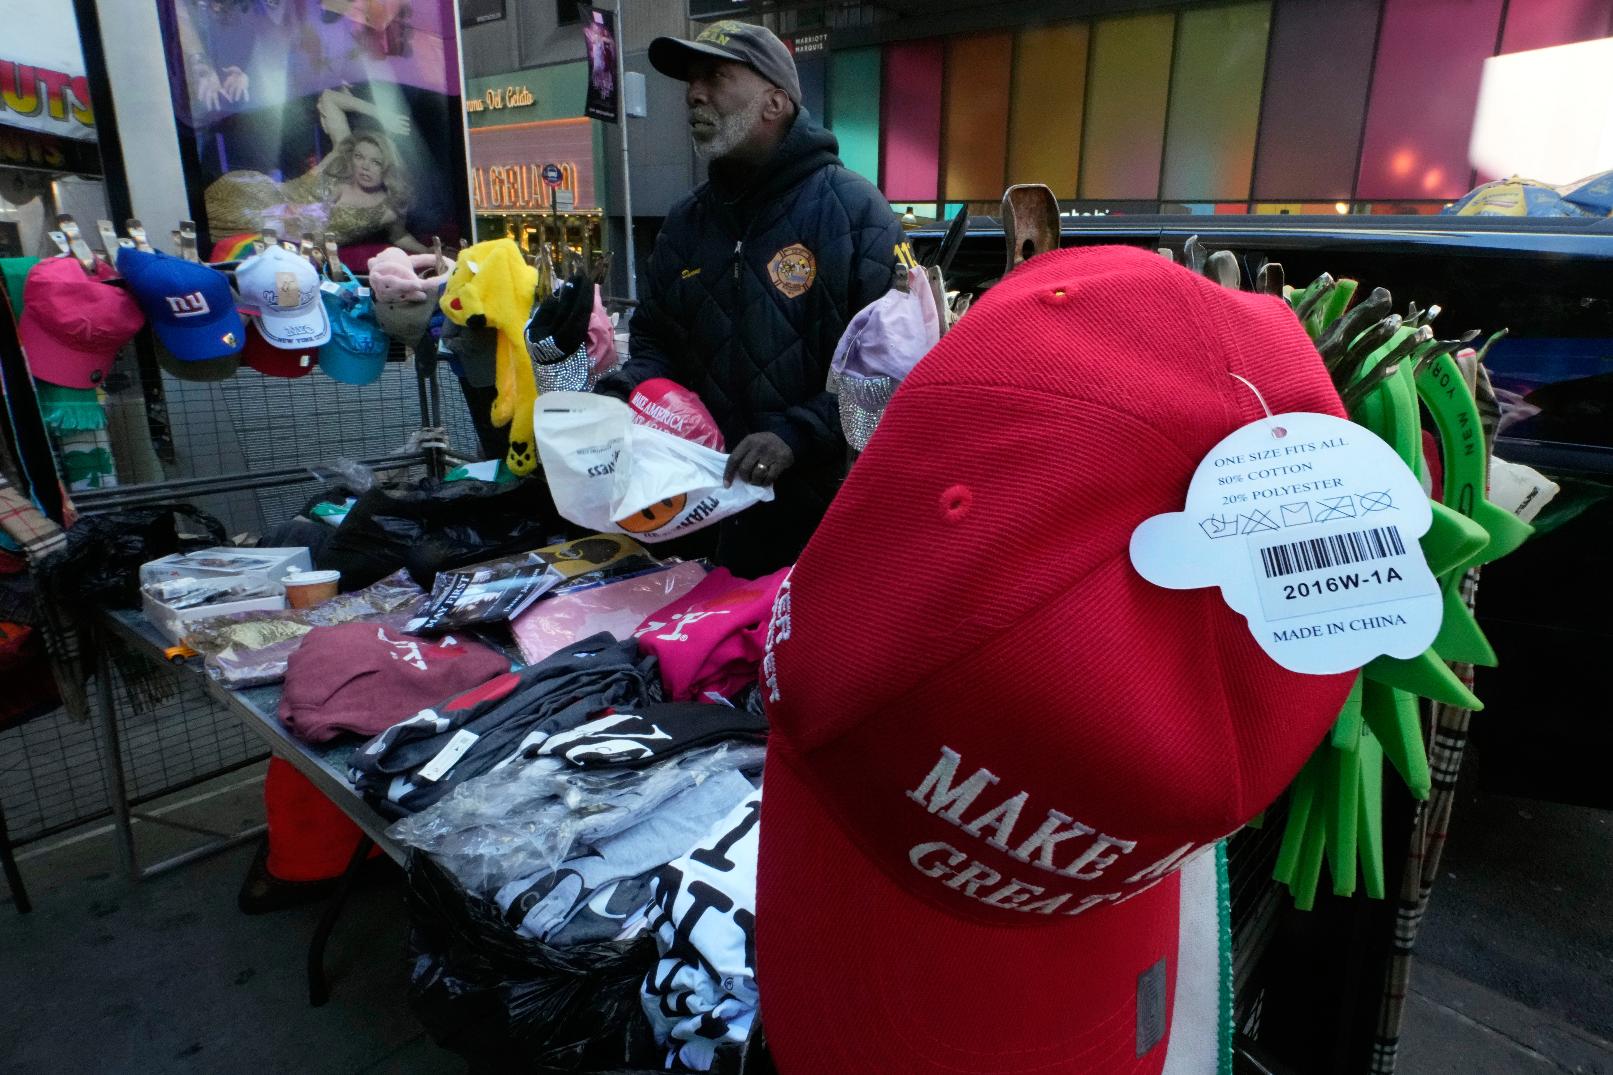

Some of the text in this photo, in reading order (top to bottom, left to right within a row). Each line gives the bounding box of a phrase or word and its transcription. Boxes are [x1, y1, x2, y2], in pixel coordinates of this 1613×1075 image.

[795, 33, 828, 44] MARRIOTT
[795, 43, 824, 52] MARQUIS
[642, 401, 684, 433] AMERICA
[1457, 411, 1475, 456] NEW
[1214, 437, 1350, 468] ONE SIZE FITS ALL
[1217, 462, 1313, 487] 80% COTTON
[1222, 477, 1345, 506] 20% POLYESTER
[1283, 567, 1403, 600] 2016W-1A
[424, 574, 471, 629] MAY FIRST
[1273, 613, 1408, 643] MADE IN CHINA
[905, 744, 1138, 881] MAKE
[908, 840, 1122, 916] GREAT
